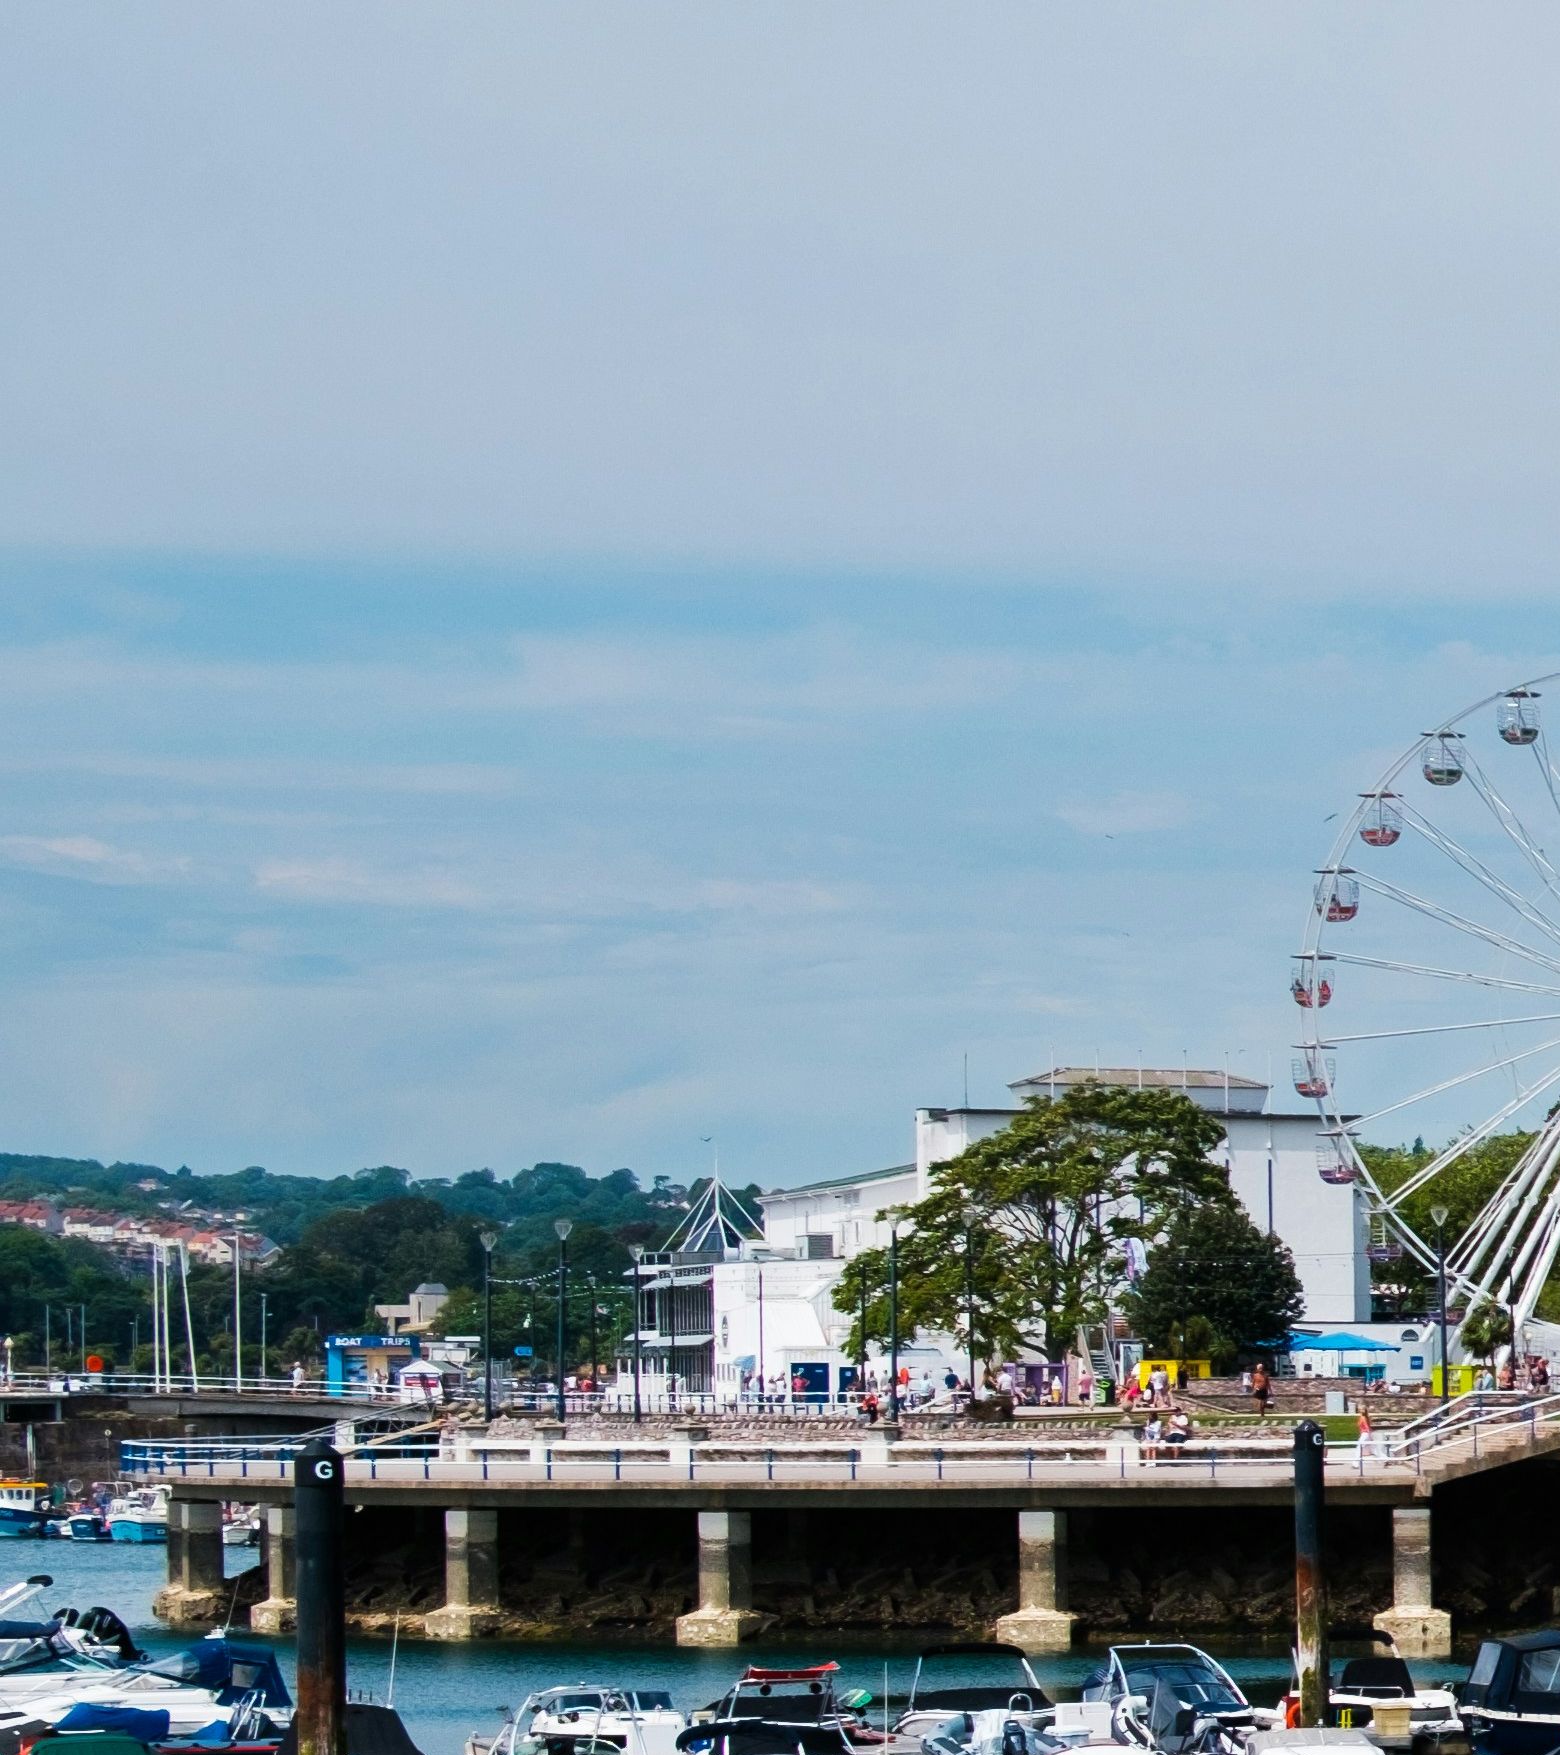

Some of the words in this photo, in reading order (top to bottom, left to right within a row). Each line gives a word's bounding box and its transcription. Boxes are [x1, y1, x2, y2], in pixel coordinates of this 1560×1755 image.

[334, 1337, 362, 1346] BOAT
[380, 1337, 411, 1346] TRIPS
[315, 1461, 333, 1479] G
